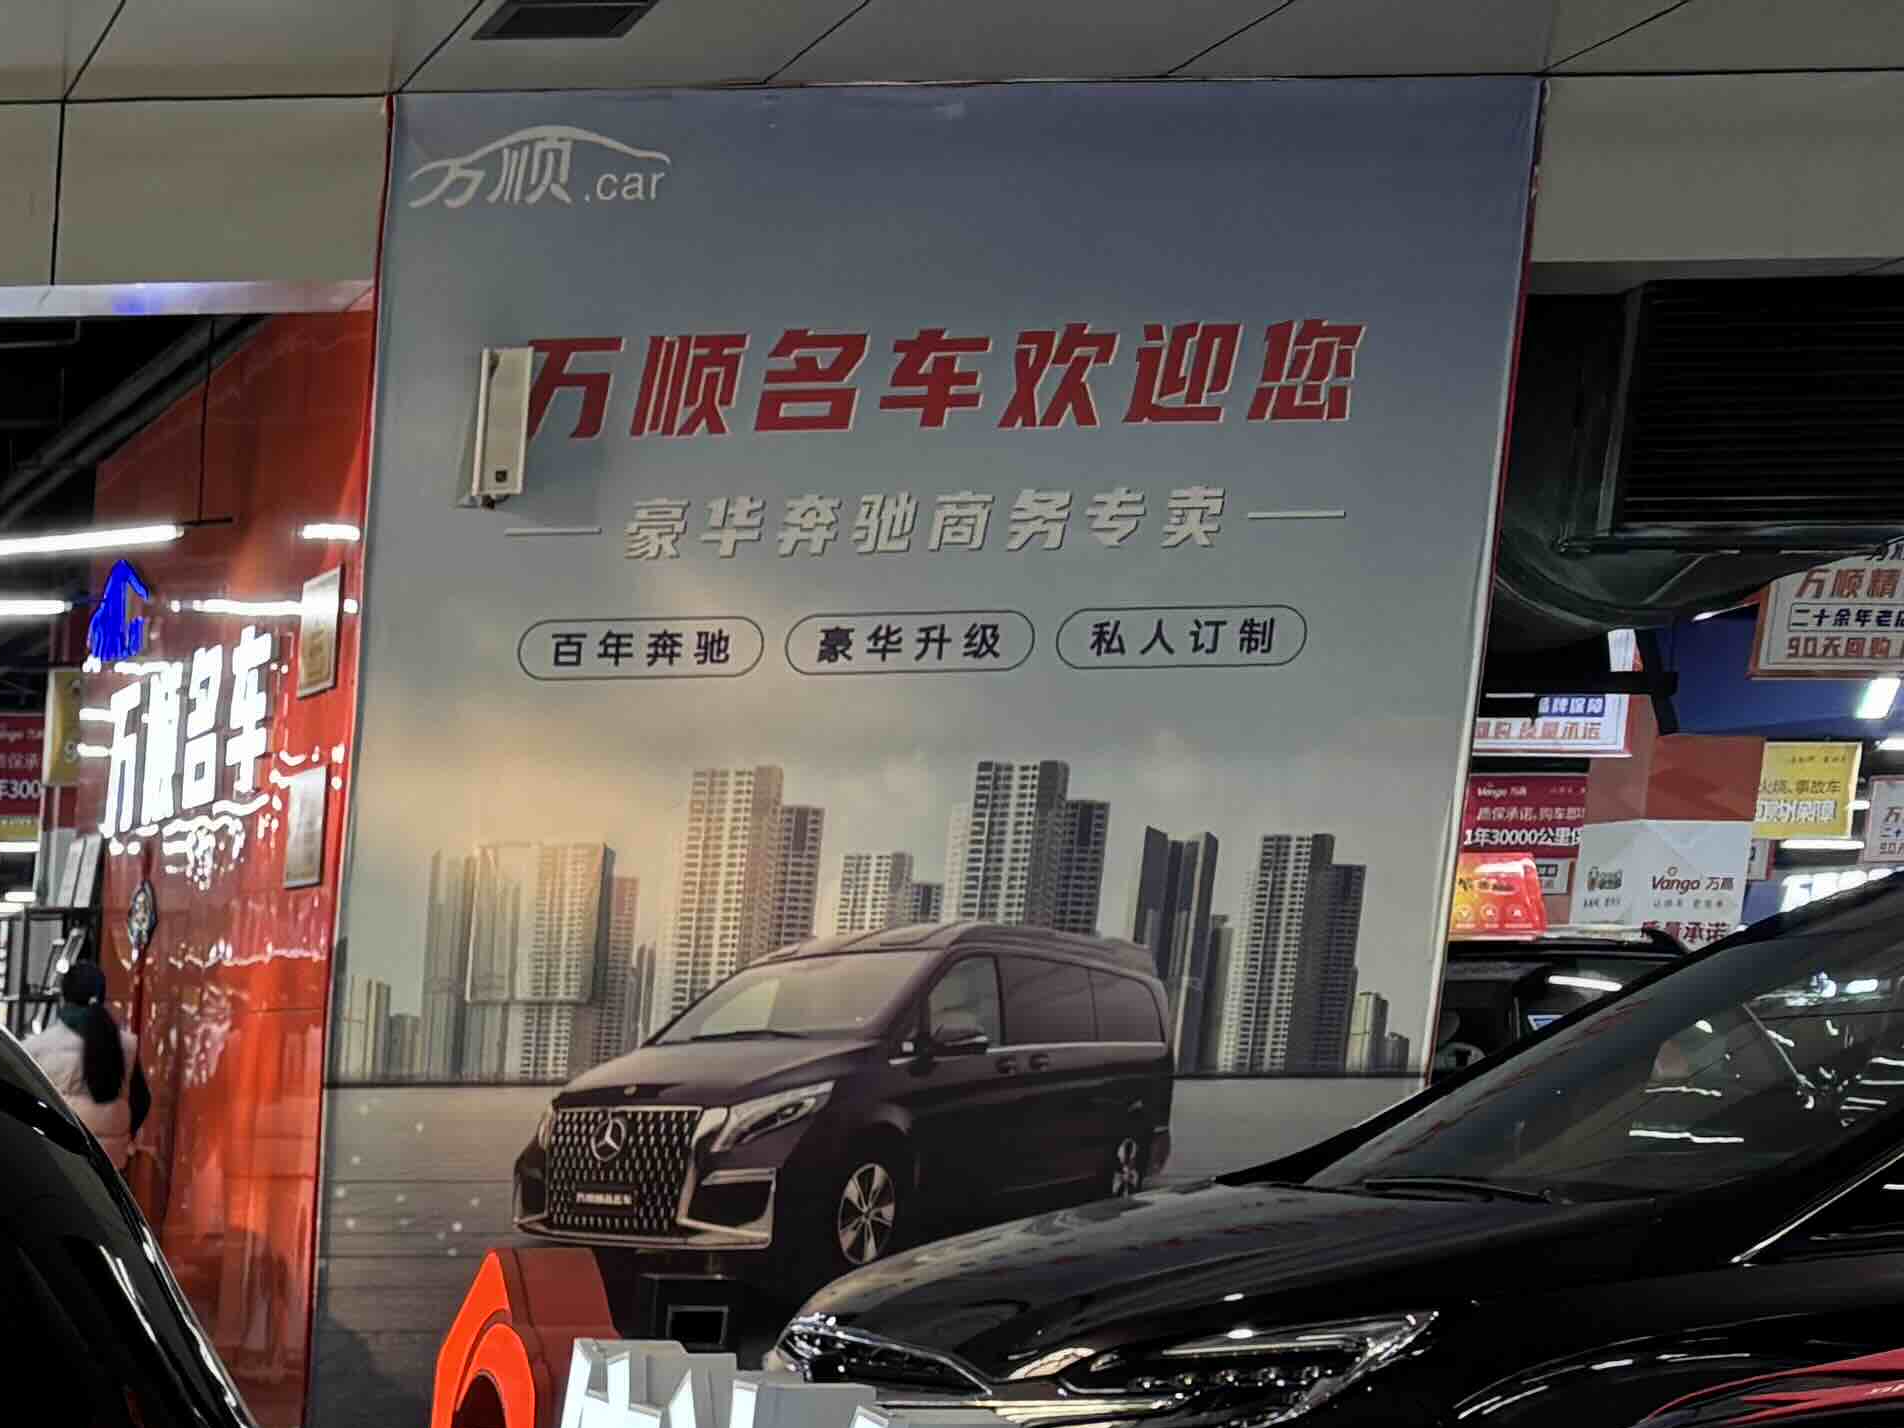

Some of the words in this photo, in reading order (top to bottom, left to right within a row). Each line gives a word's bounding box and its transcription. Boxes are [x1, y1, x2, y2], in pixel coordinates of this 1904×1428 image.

[528, 317, 1367, 441] 万顺名车欢迎您
[622, 485, 1227, 560] 豪华奔驰商务专卖
[552, 626, 733, 669] 百年奔驰
[817, 620, 1003, 665] 豪华升级
[1089, 616, 1277, 659] 私人订制
[1651, 875, 1701, 895] Vango
